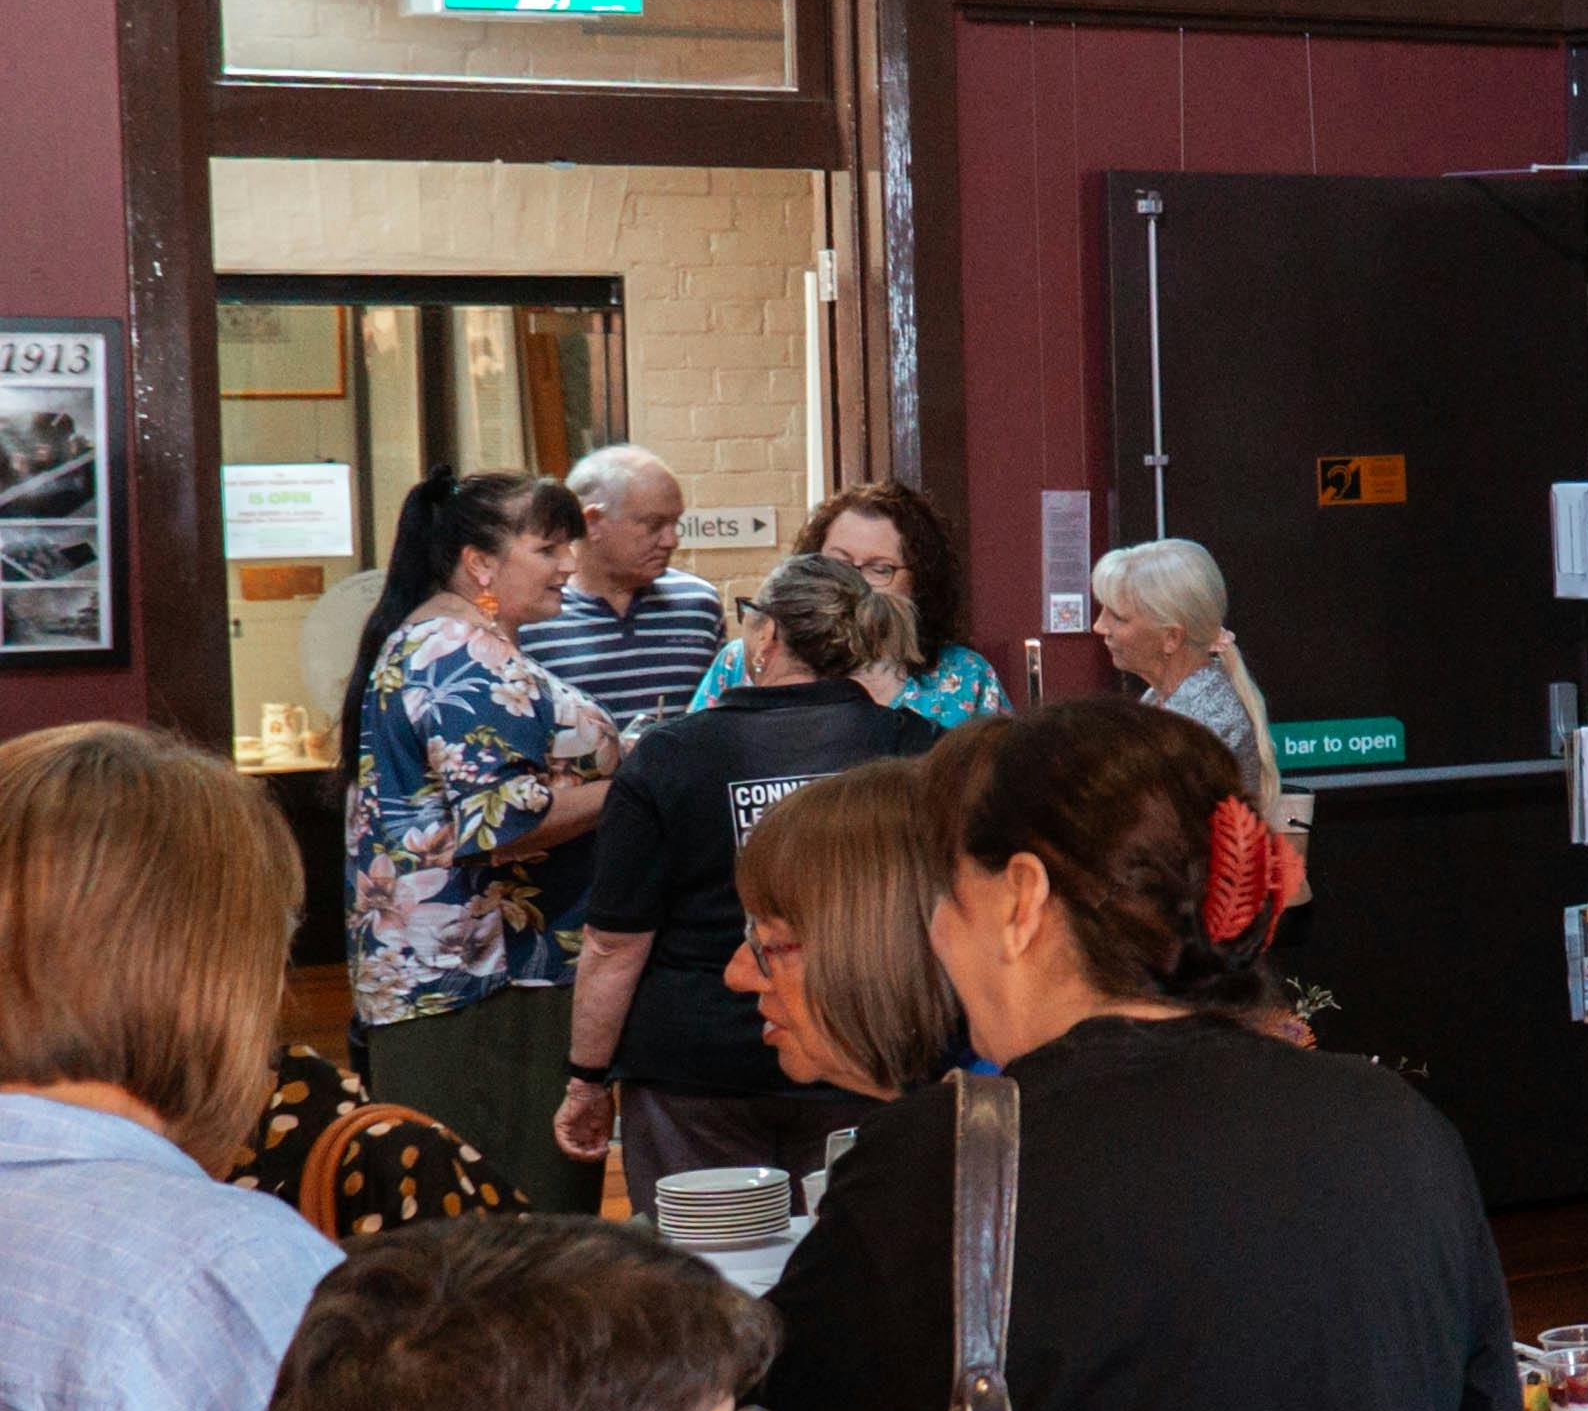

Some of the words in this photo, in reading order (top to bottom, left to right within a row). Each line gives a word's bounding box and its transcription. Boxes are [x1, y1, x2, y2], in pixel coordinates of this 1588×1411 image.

[0, 343, 91, 374] 1913
[674, 517, 739, 537] oilets
[1284, 735, 1317, 755] bar
[1323, 735, 1343, 753] to
[1349, 734, 1397, 755] open
